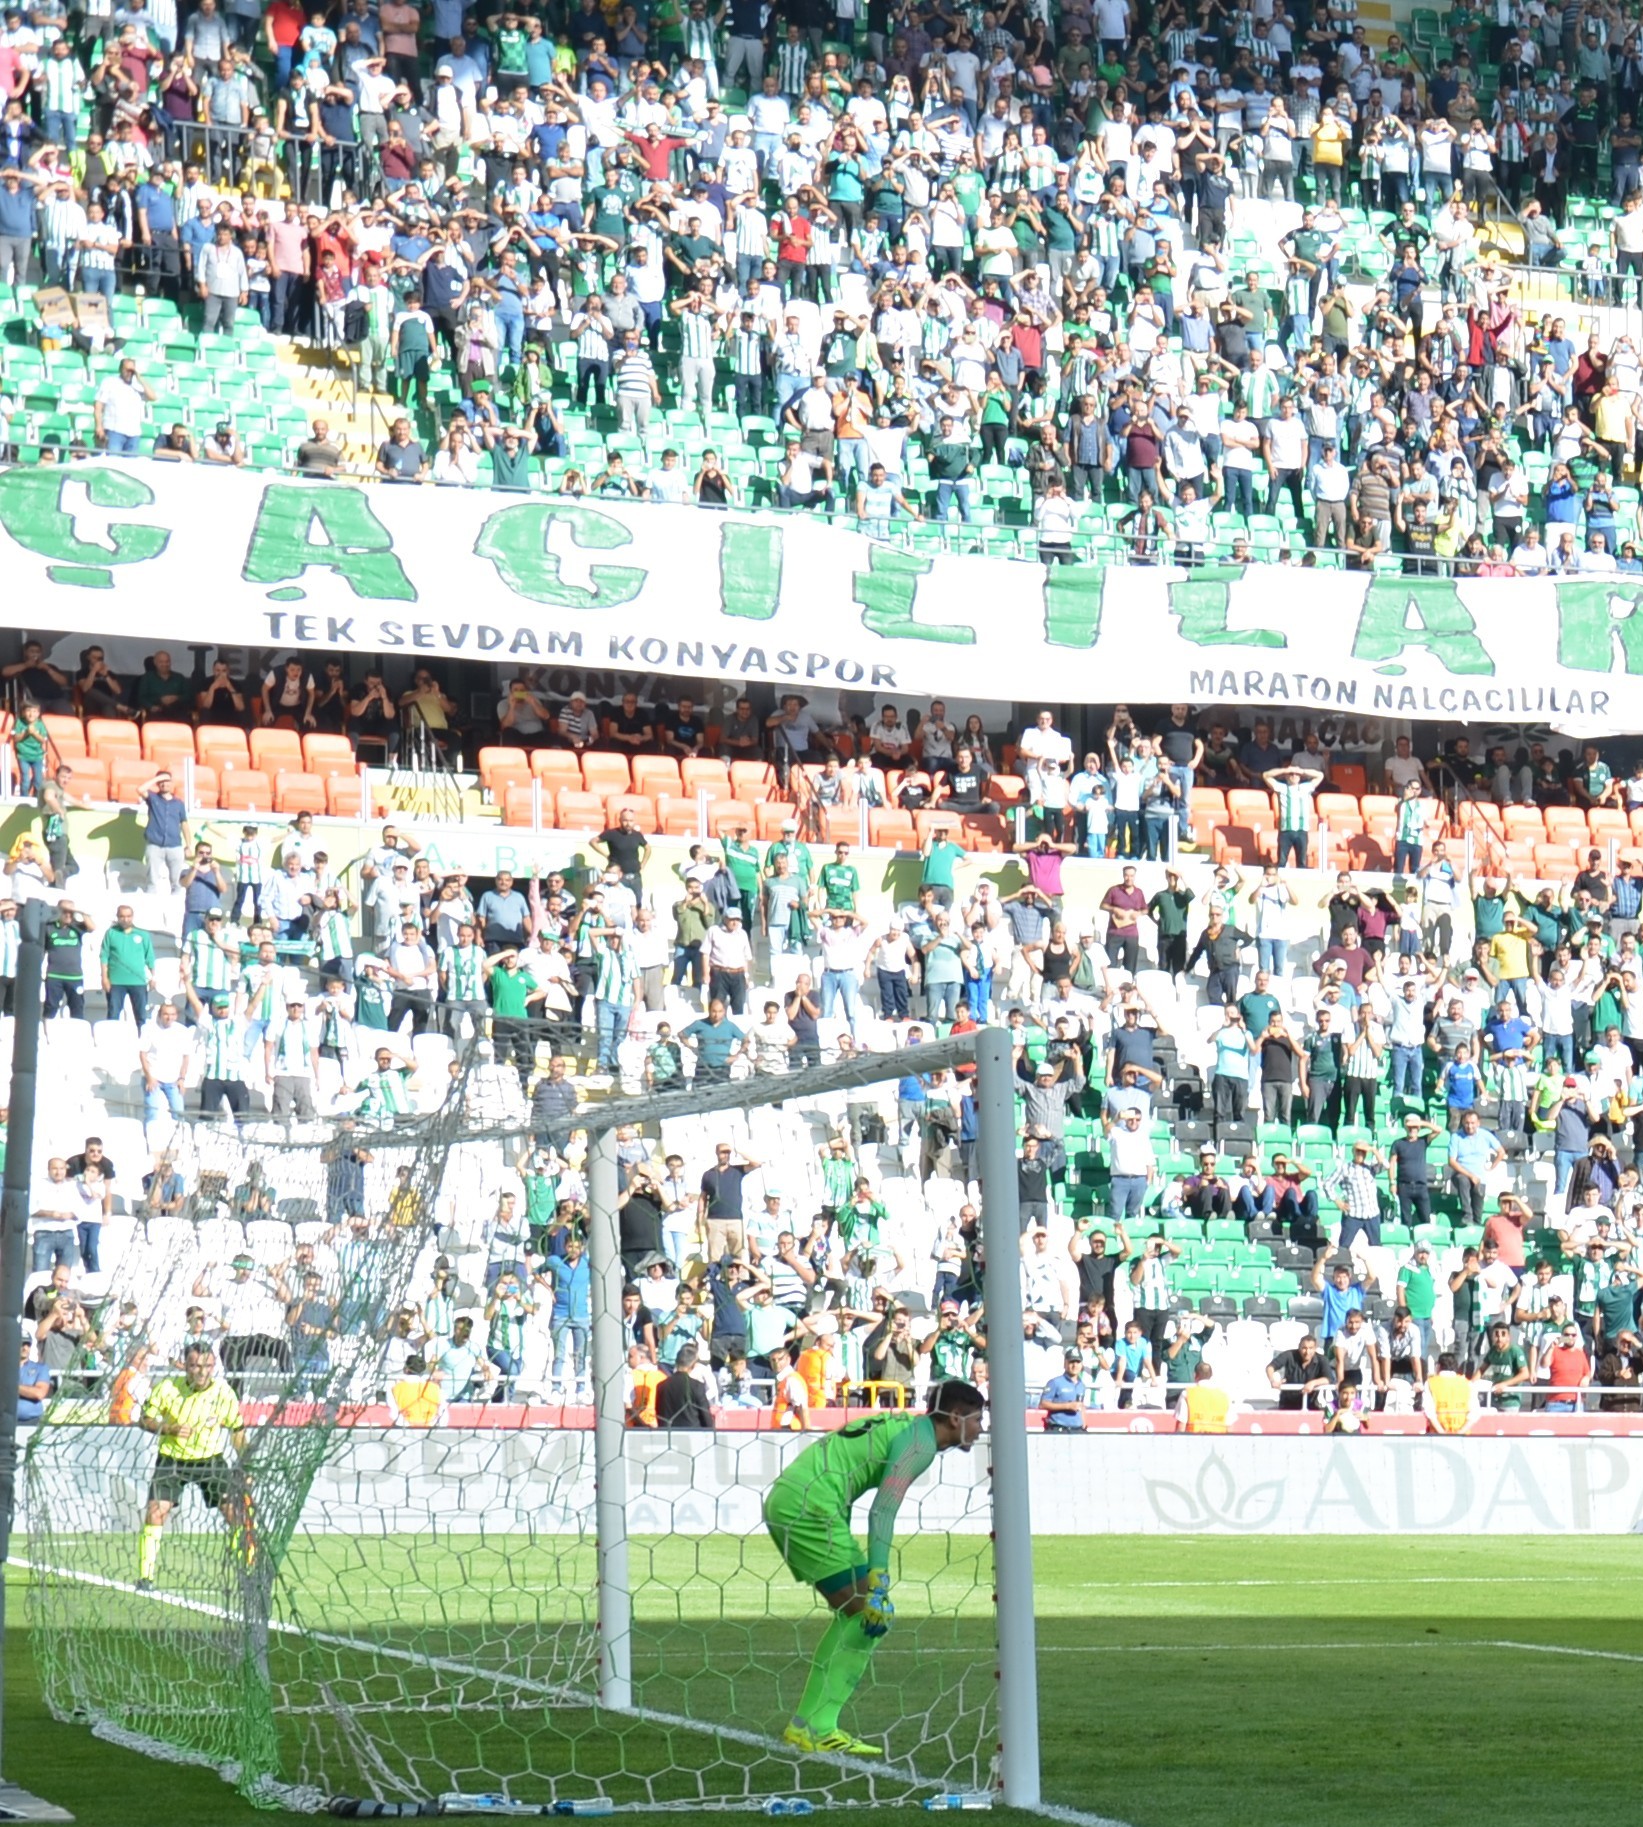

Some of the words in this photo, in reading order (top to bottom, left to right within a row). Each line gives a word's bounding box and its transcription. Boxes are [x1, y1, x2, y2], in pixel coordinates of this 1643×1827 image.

[263, 612, 356, 644] TEK
[377, 617, 585, 659] SEVDAM
[607, 635, 898, 688] KONYASPOR
[1189, 669, 1357, 706] MARATON
[516, 1497, 740, 1528] İNAAT
